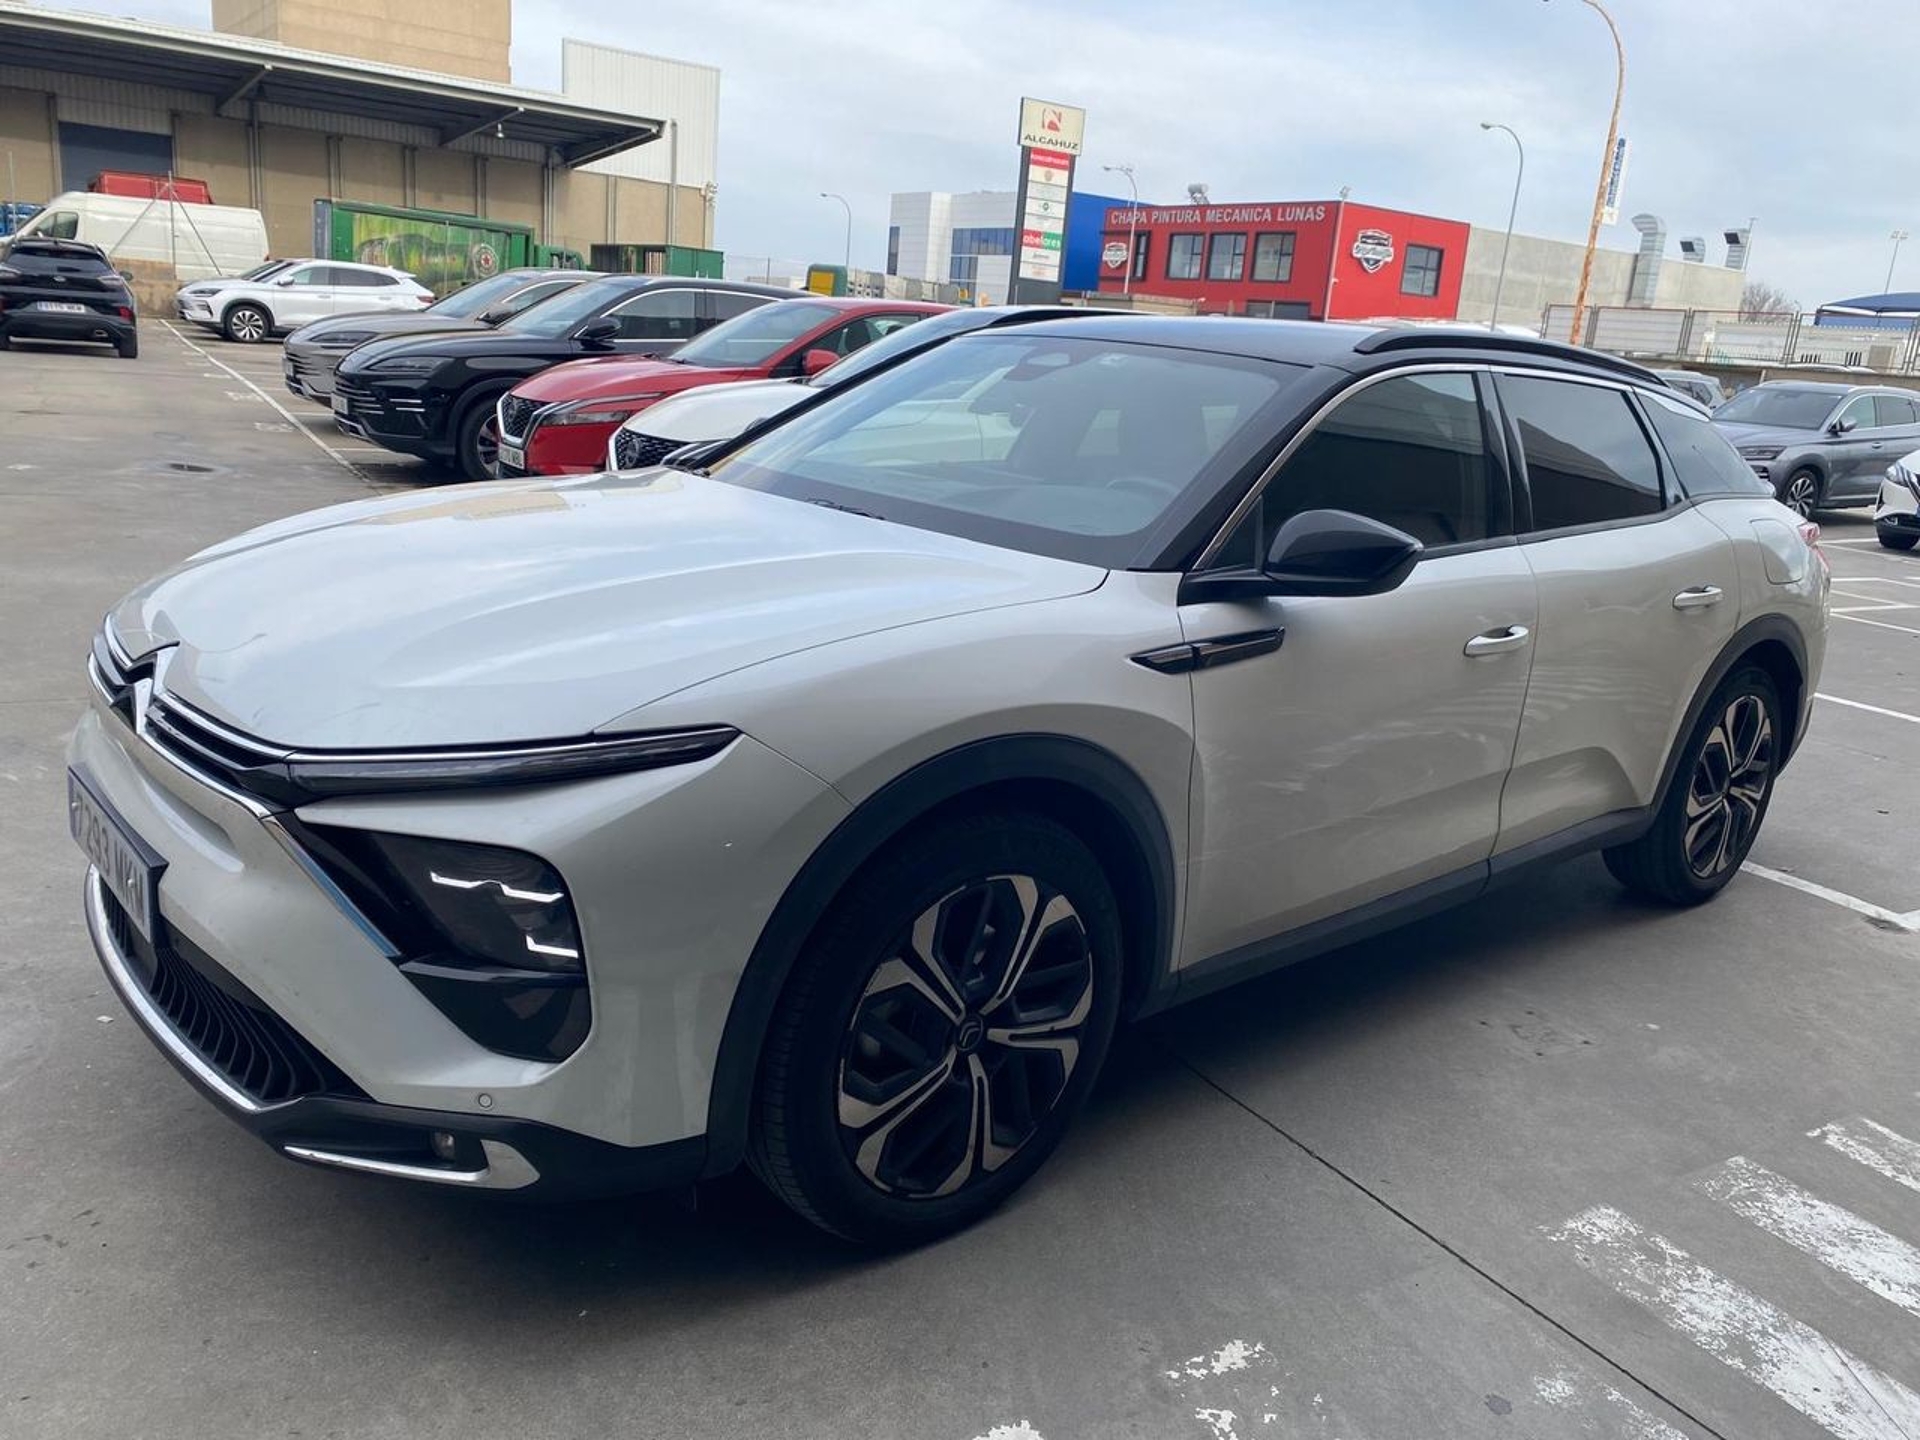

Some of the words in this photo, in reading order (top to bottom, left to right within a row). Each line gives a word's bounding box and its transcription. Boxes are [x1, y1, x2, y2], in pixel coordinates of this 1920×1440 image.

[1024, 134, 1078, 152] ALCAHUZ
[1110, 209, 1147, 224] CHAPA
[1151, 209, 1201, 224] PINTURA
[1205, 207, 1272, 223] MECANICA
[1276, 205, 1325, 222] LUNAS
